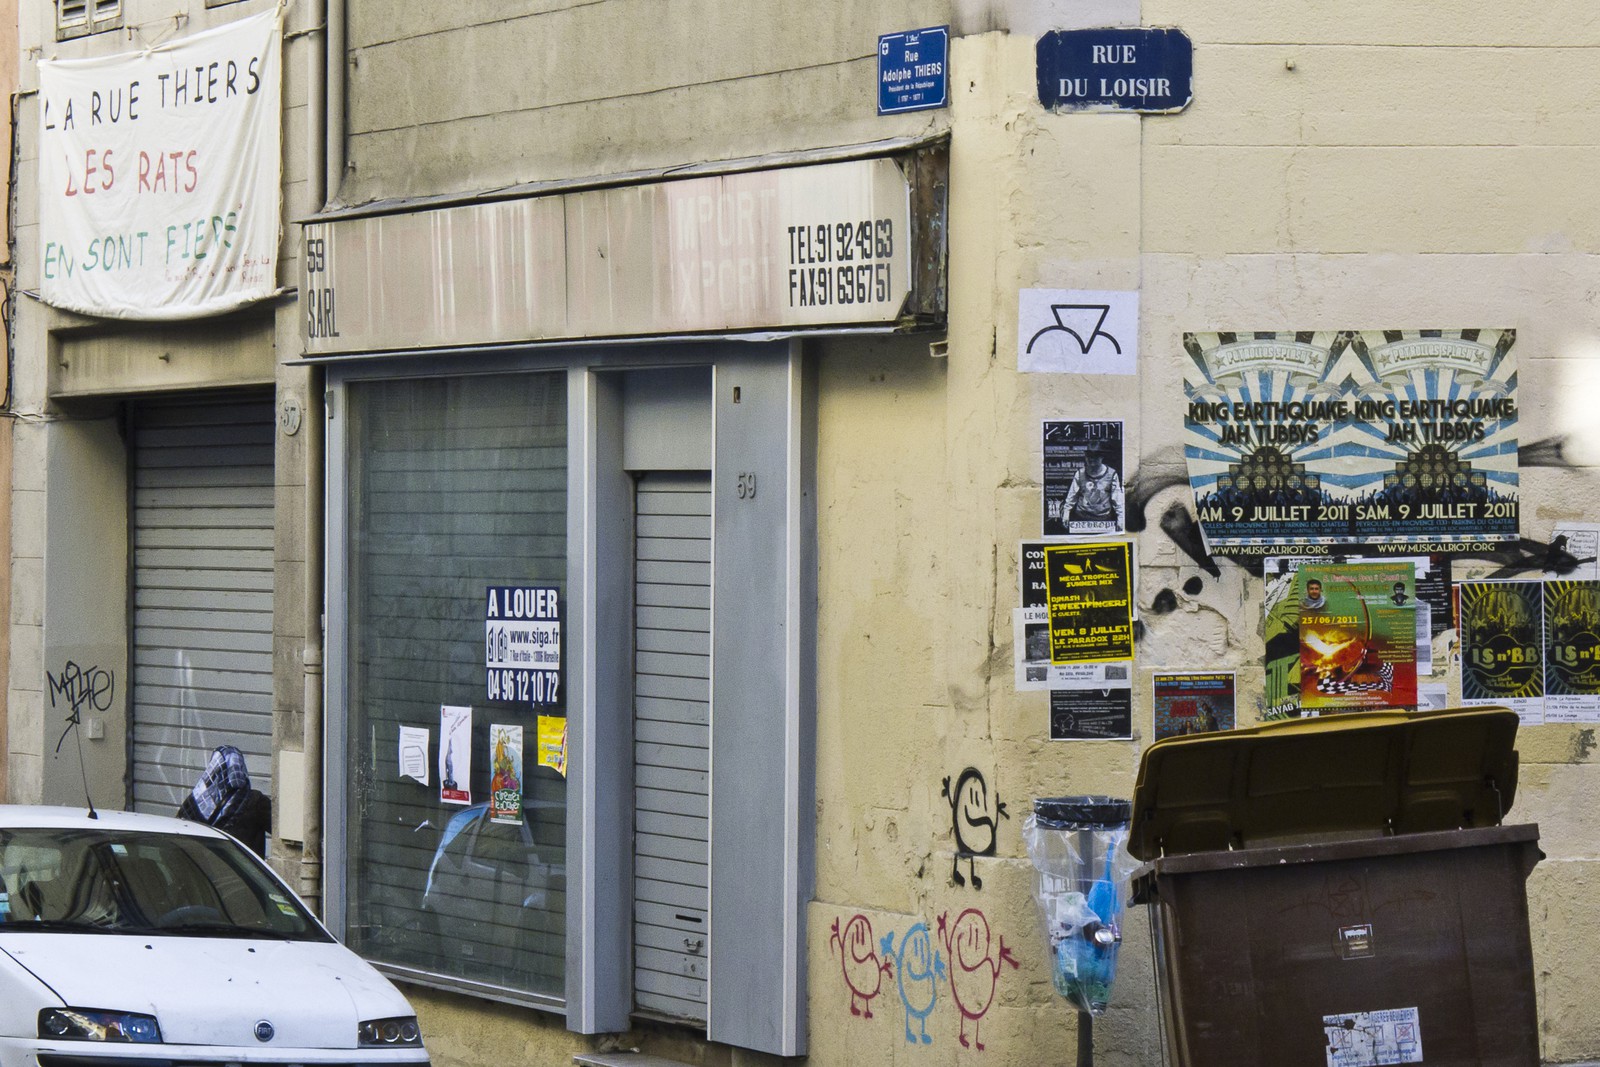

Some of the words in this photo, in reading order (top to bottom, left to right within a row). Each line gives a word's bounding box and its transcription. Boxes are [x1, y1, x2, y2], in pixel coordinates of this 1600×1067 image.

[904, 50, 919, 62] Rue
[1092, 45, 1136, 63] RUE
[882, 67, 912, 82] Adolphe
[914, 62, 942, 77] THIERS
[45, 98, 75, 131] LA
[92, 81, 140, 126] RUE
[158, 57, 260, 108] THIERS
[1059, 79, 1088, 97] DU
[1100, 79, 1171, 97] LOISIR
[65, 149, 115, 197] LES
[138, 150, 198, 194] RATS
[836, 222, 854, 262] 92
[856, 221, 873, 260] 49
[875, 218, 893, 259] 63
[45, 242, 74, 279] EN
[82, 232, 149, 272] SONT
[307, 239, 325, 274] 59
[837, 265, 854, 305] 69
[856, 264, 873, 304] 67
[876, 263, 891, 303] 51
[307, 288, 339, 338] SARL
[1189, 402, 1229, 421] KING
[1234, 401, 1348, 421] EARTHQUAKE
[1355, 401, 1395, 419] KING
[1400, 399, 1514, 419] EARTHQUAKE
[1218, 425, 1249, 444] JAH
[1256, 424, 1319, 444] TUBBYS
[1384, 422, 1416, 442] JAH
[1423, 422, 1485, 442] TUBBYS
[738, 471, 756, 499] 59
[1200, 510, 1225, 522] AM.
[1231, 507, 1243, 522] 9
[1250, 506, 1311, 521] JUILLET
[1317, 506, 1349, 521] 2011
[1356, 505, 1392, 520] SAM.
[1399, 504, 1410, 520] 9
[1416, 503, 1478, 519] JUILLET
[1484, 502, 1516, 518] 2011
[1211, 545, 1329, 555] WWW.MUSICALRIOT.ORG
[1378, 543, 1495, 553] WWW.MUSICALRIOT.ORG
[1082, 573, 1119, 581] TROPICAL
[488, 589, 499, 617] A
[504, 588, 558, 618] LOUER
[1301, 617, 1313, 625] 25
[1319, 616, 1331, 624] 06
[1337, 615, 1358, 623] 2011
[510, 627, 559, 648] www.siga.fr
[1068, 636, 1108, 644] PARADOX
[1090, 625, 1129, 636] JUILLET
[487, 669, 500, 700] 04
[502, 670, 514, 701] 96
[516, 671, 529, 701] 12
[531, 671, 544, 702] 10
[546, 671, 558, 702] 72
[1267, 702, 1294, 716] SAYAG
